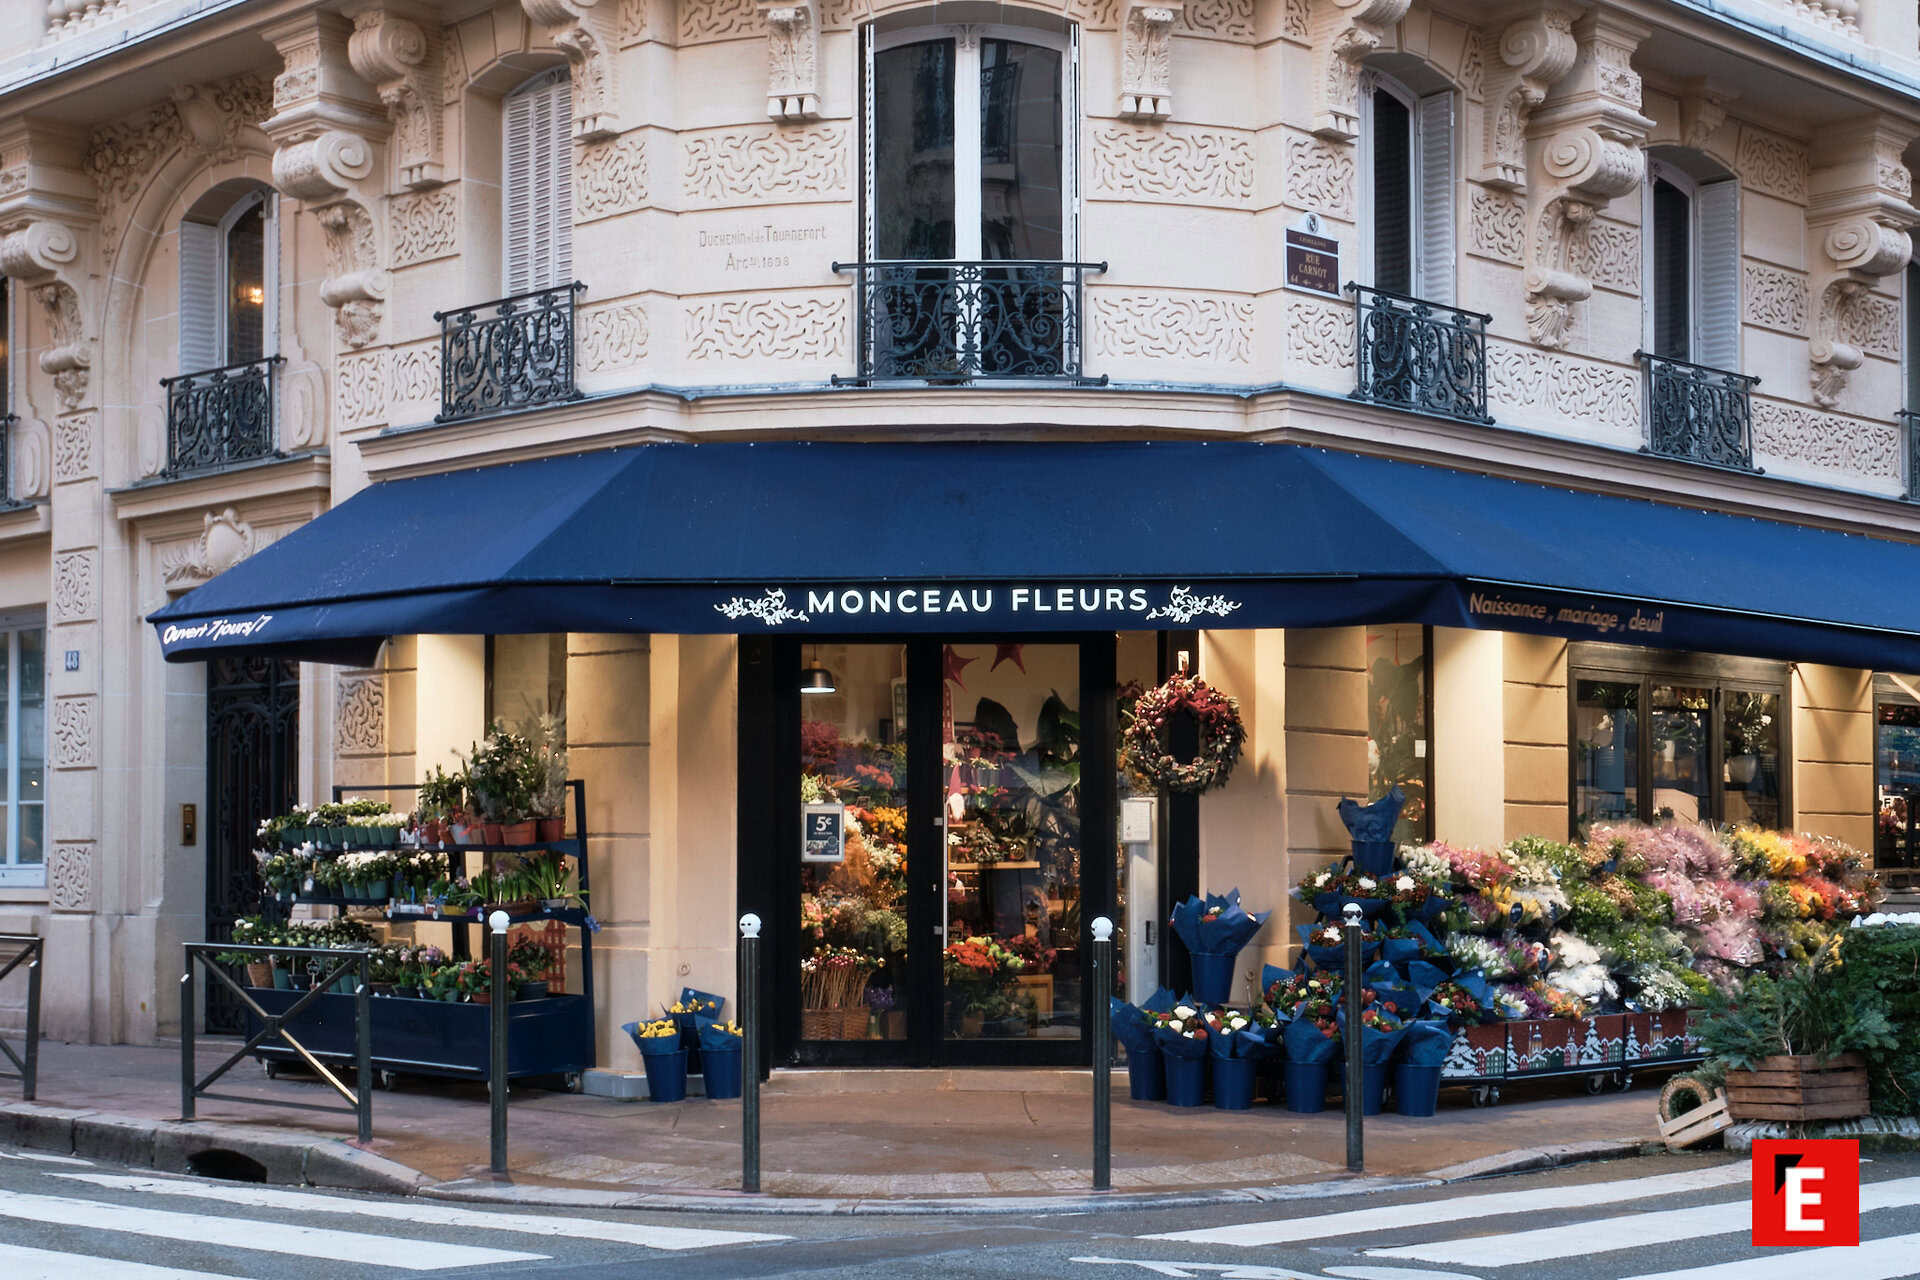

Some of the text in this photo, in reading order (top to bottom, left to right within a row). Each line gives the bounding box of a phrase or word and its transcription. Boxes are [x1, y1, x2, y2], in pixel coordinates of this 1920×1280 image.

[1305, 253, 1320, 265] RUE
[1298, 264, 1327, 278] CARNOT
[808, 588, 1148, 614] MONCEAU FLEURS
[1628, 608, 1663, 633] deuil
[163, 624, 208, 645] Ouvert
[66, 652, 78, 669] 48
